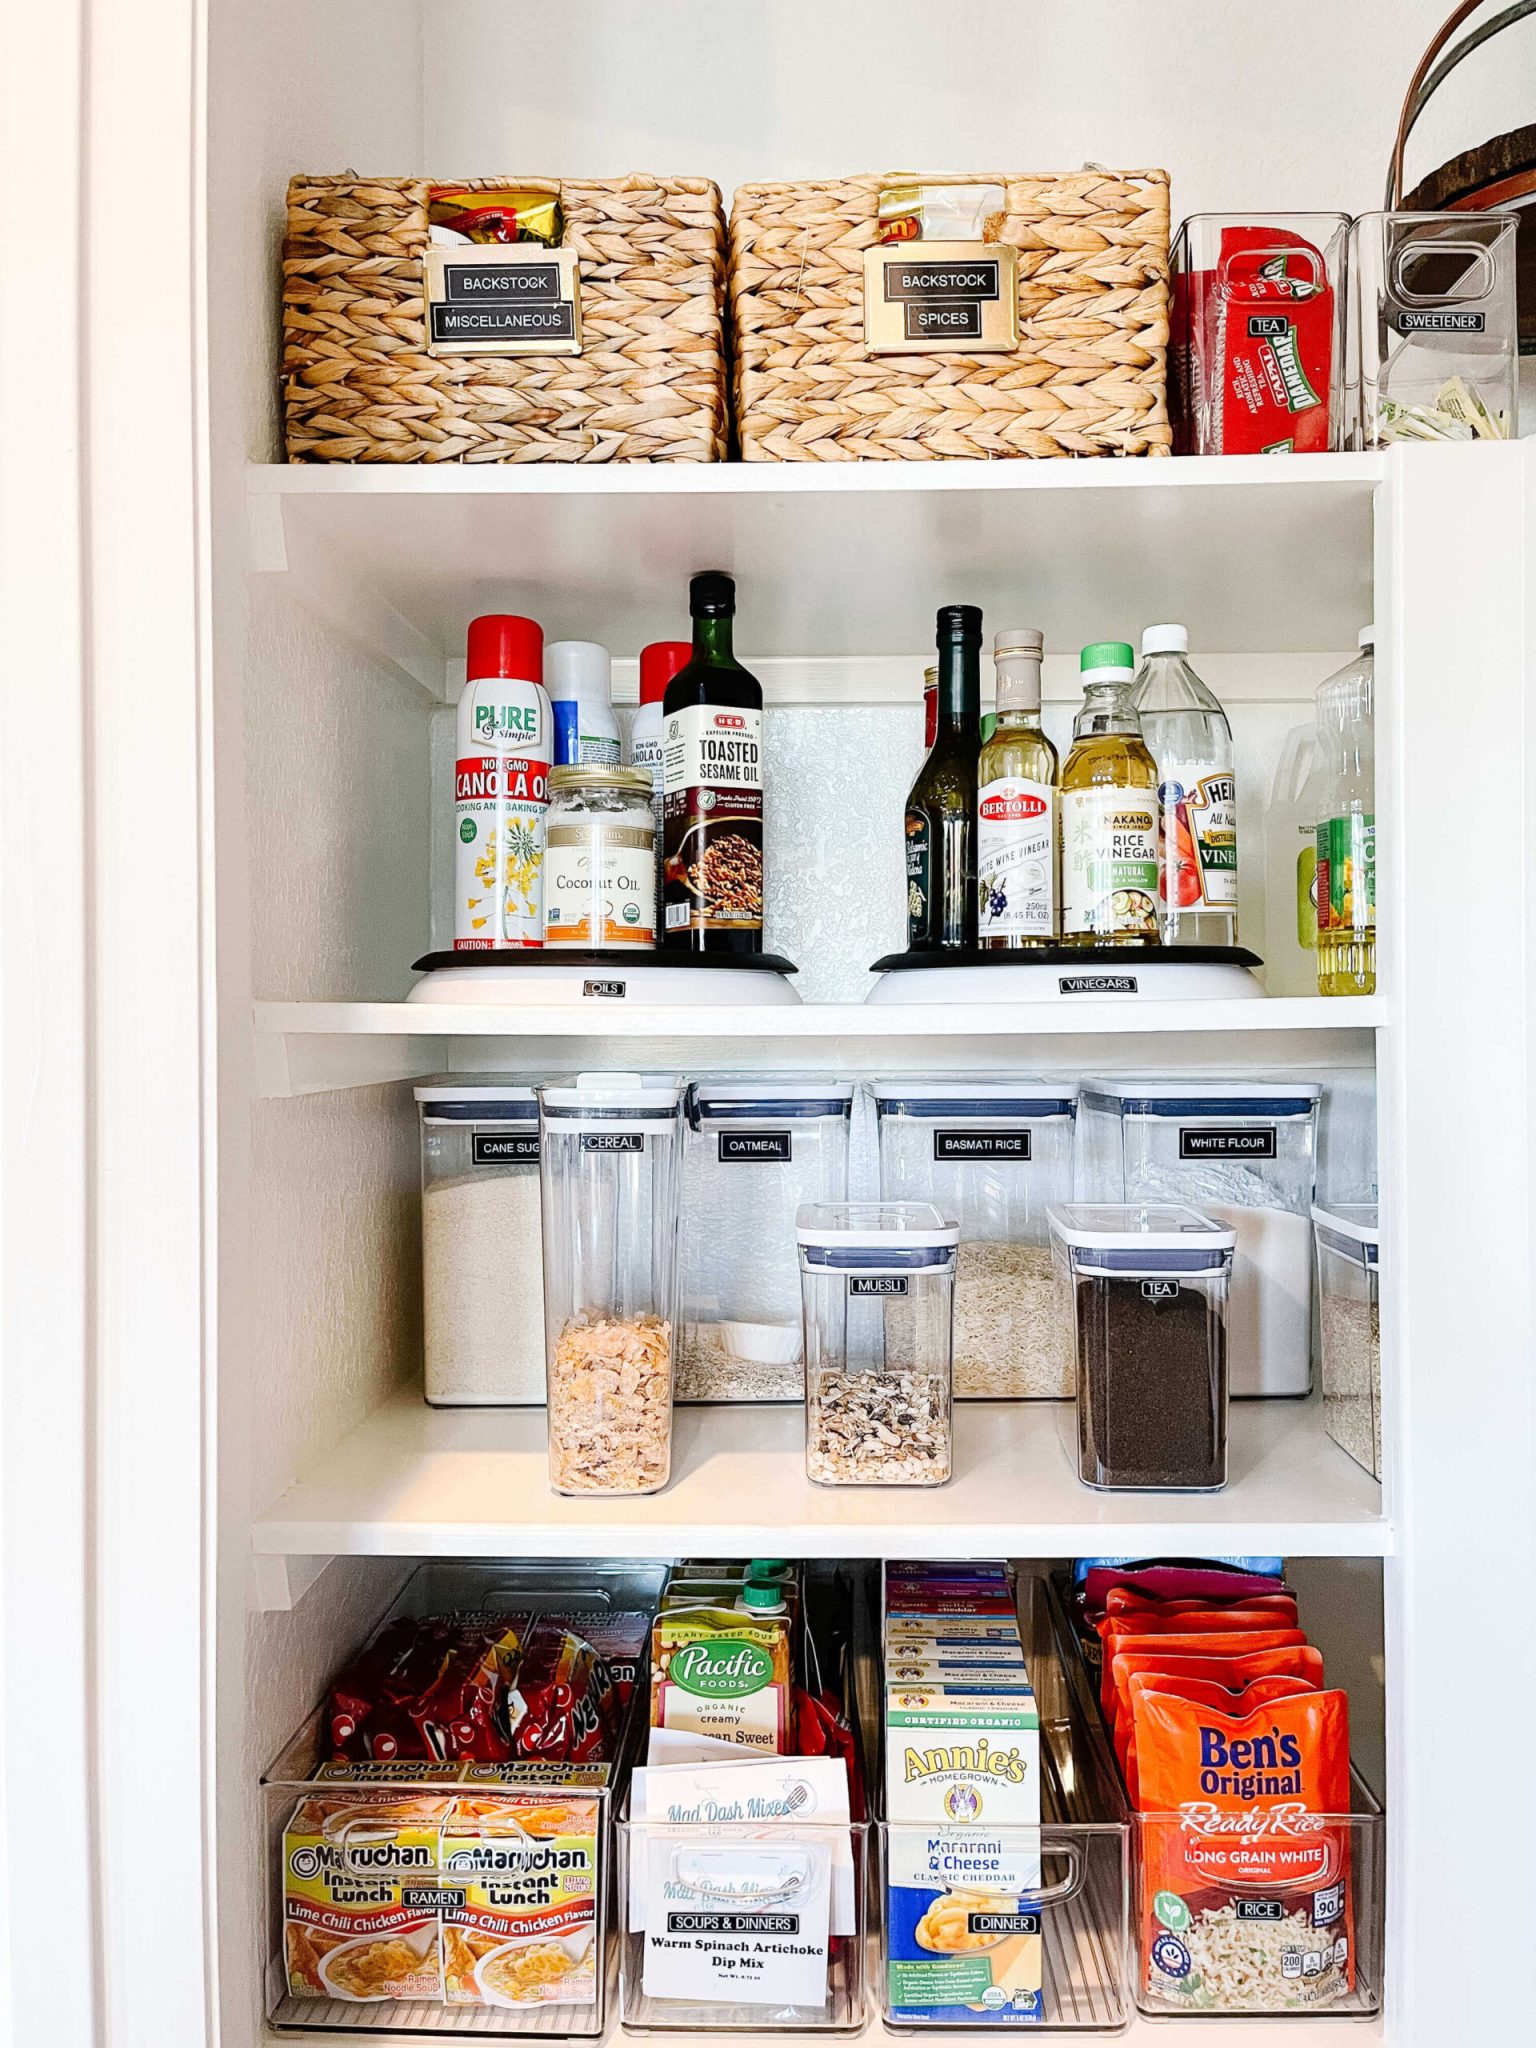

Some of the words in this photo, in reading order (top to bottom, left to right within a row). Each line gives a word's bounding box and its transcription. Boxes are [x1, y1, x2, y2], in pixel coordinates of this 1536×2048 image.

[463, 276, 548, 290] BACKSTOCK
[902, 273, 987, 288] BACKSTOCK
[445, 313, 562, 329] MISCELLANEOUS
[918, 312, 969, 326] SPICES
[1255, 319, 1280, 332] TEA
[1405, 314, 1477, 328] SWEETENER
[1242, 358, 1264, 407] REFRESHING
[1263, 348, 1286, 404] TAPAL
[1238, 374, 1258, 414] AROMATIC
[475, 705, 537, 732] PURE
[499, 729, 535, 742] Simple
[699, 739, 758, 764] TOASTED
[481, 759, 529, 772] NON-GMO
[699, 763, 741, 781] SESAME
[743, 766, 759, 782] OIL
[456, 771, 528, 798] CANOLA
[505, 802, 538, 814] BAKING
[982, 801, 1043, 817] BERTOLLI
[1104, 815, 1152, 825] NAKANO
[1113, 835, 1144, 847] RICE
[995, 851, 1015, 867] WINE
[1019, 839, 1050, 858] VINEGAR
[1096, 848, 1155, 860] VINEGAR
[1112, 866, 1146, 876] NATURAL
[591, 983, 618, 994] OILS
[1067, 979, 1130, 990] VINEGARS
[484, 1143, 514, 1154] CANE
[517, 1142, 540, 1153] SUG
[587, 1136, 637, 1148] CEREAL
[729, 1140, 783, 1152] OATMEAL
[945, 1139, 993, 1151] BASMATI
[995, 1139, 1022, 1150] RICE
[1190, 1138, 1226, 1148] WHITE
[1228, 1137, 1265, 1148] FLOUR
[858, 1280, 903, 1292] MUESLI
[1148, 1282, 1170, 1295] TEA
[671, 1630, 743, 1639] PLANT-BASED
[680, 1646, 767, 1680] Pacific
[700, 1680, 745, 1688] FOODS
[696, 1703, 746, 1713] ORGANIC
[700, 1715, 741, 1725] creamy
[904, 1716, 968, 1726] CERTIFIED
[970, 1718, 1021, 1727] ORGANIC
[735, 1730, 774, 1745] Sweet
[1199, 1726, 1302, 1769] Ben's
[904, 1738, 1028, 1784] Annie's
[929, 1772, 998, 1787] HOMEGROWN
[1200, 1769, 1302, 1800] Original
[667, 1804, 702, 1822] Mad
[704, 1801, 744, 1822] Dash
[747, 1798, 791, 1818] Mixes
[1179, 1801, 1271, 1845] Ready
[1270, 1802, 1327, 1837] Rice
[944, 1856, 1000, 1870] Cheese
[1184, 1851, 1227, 1864] LONG
[1229, 1851, 1276, 1864] GRAIN
[1279, 1849, 1322, 1864] WHITE
[962, 1874, 1016, 1882] CHEDDAR
[331, 1886, 394, 1903] Lunch
[410, 1892, 458, 1905] RAMEN
[489, 1888, 551, 1905] Lunch
[288, 1902, 320, 1921] Lime
[321, 1912, 351, 1930] Chili
[353, 1911, 406, 1931] Chicken
[406, 1907, 437, 1919] Flavor
[1244, 1904, 1275, 1917] RICE
[445, 1909, 477, 1924] Lime
[479, 1915, 508, 1933] Chili
[510, 1913, 563, 1934] Chicken
[564, 1909, 594, 1921] Flavor
[676, 1916, 719, 1929] SOUPS
[722, 1917, 732, 1929] &
[735, 1917, 791, 1931] DINNERS
[980, 1917, 1029, 1930] DINNER
[651, 1937, 691, 1949] Warm
[695, 1939, 750, 1952] Spinach
[754, 1942, 824, 1956] Artichoke
[712, 1956, 736, 1970] Dip
[739, 1958, 765, 1969] Mix
[1283, 1955, 1300, 1966] 200
